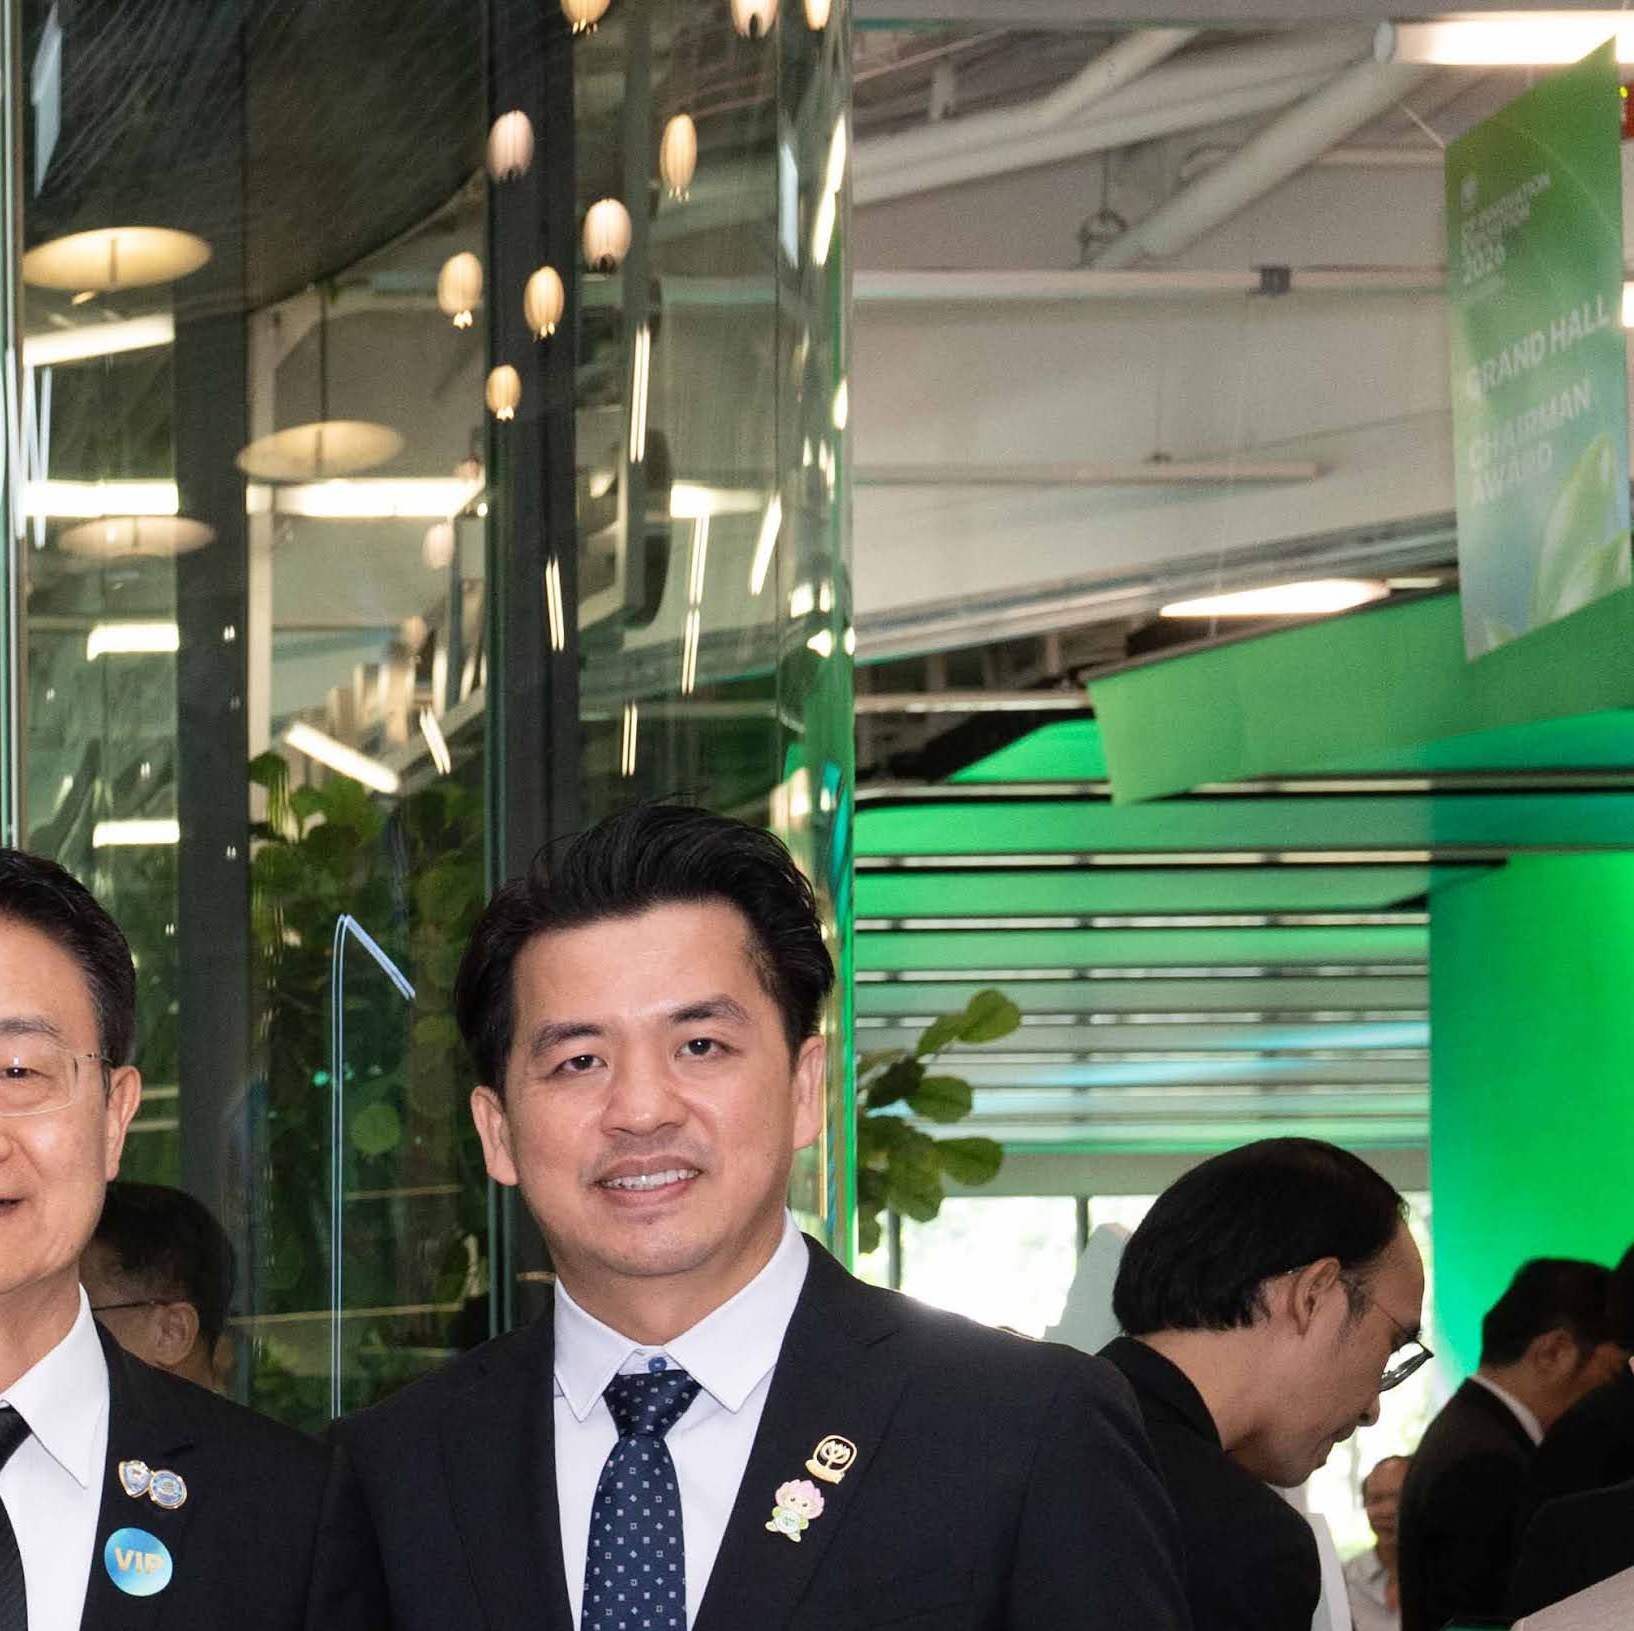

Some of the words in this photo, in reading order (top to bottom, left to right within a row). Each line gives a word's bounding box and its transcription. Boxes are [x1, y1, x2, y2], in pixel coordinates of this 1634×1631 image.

[1467, 332, 1545, 398] GRAND
[1550, 294, 1612, 353] HALL
[1469, 380, 1591, 469] CHAIRMAN
[114, 1547, 163, 1574] VIP
